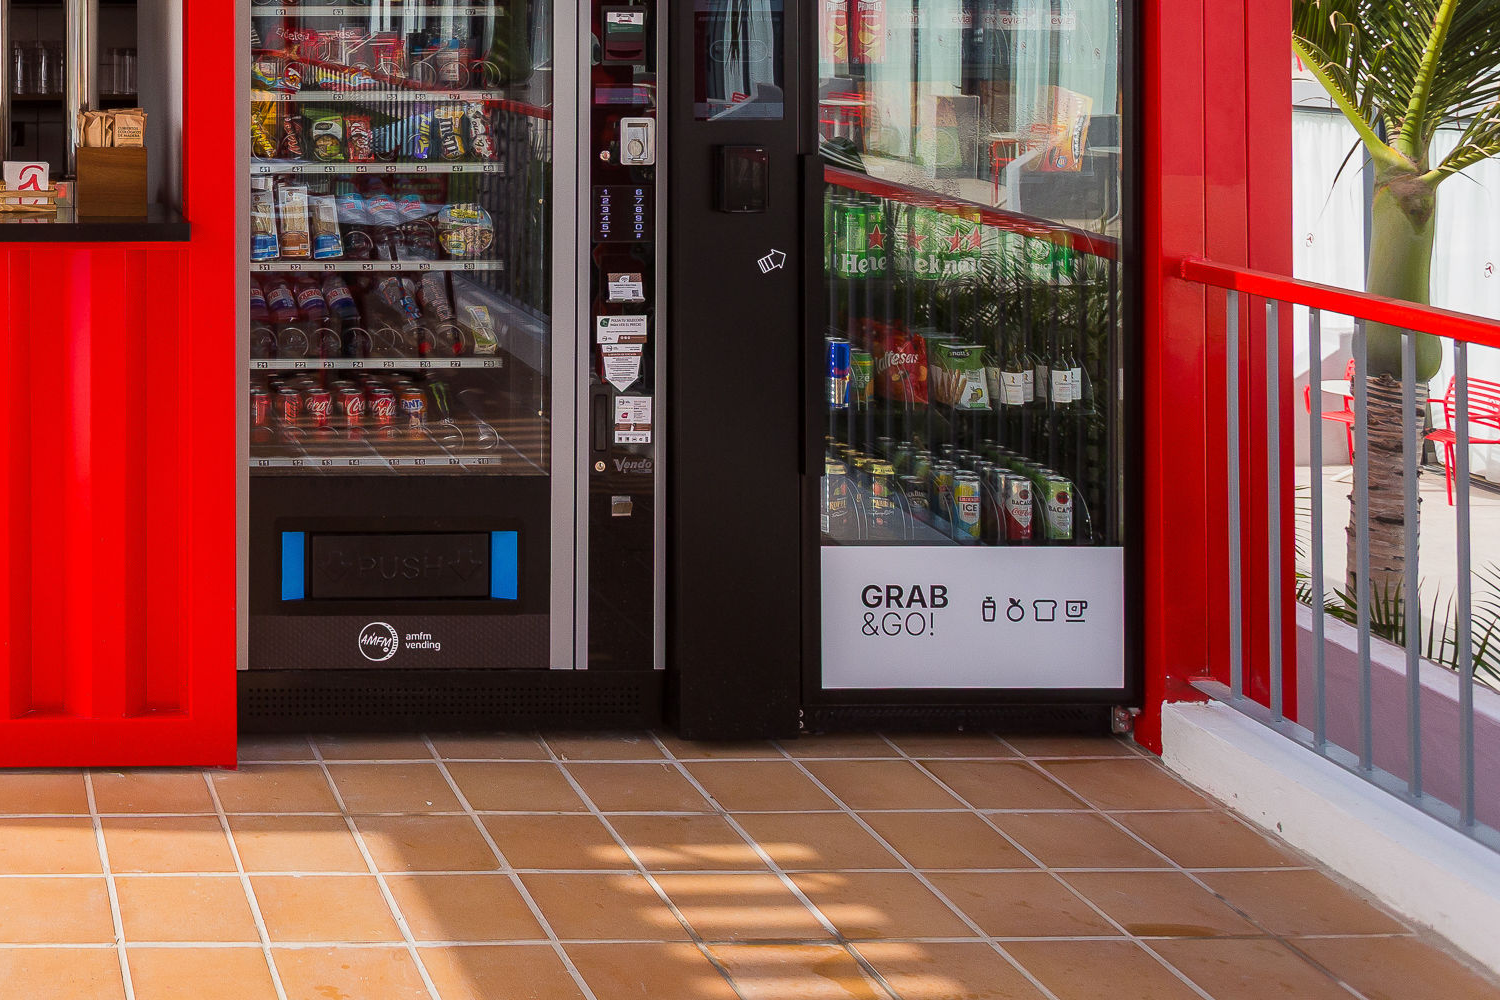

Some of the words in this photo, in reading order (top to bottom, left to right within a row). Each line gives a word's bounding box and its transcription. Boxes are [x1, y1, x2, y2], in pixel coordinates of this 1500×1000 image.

[614, 457, 652, 472] Vendo
[359, 556, 442, 579] PUSH
[861, 584, 949, 609] GRAB
[861, 612, 935, 636] &GO!
[406, 631, 432, 640] amfm
[405, 640, 441, 651] vending
